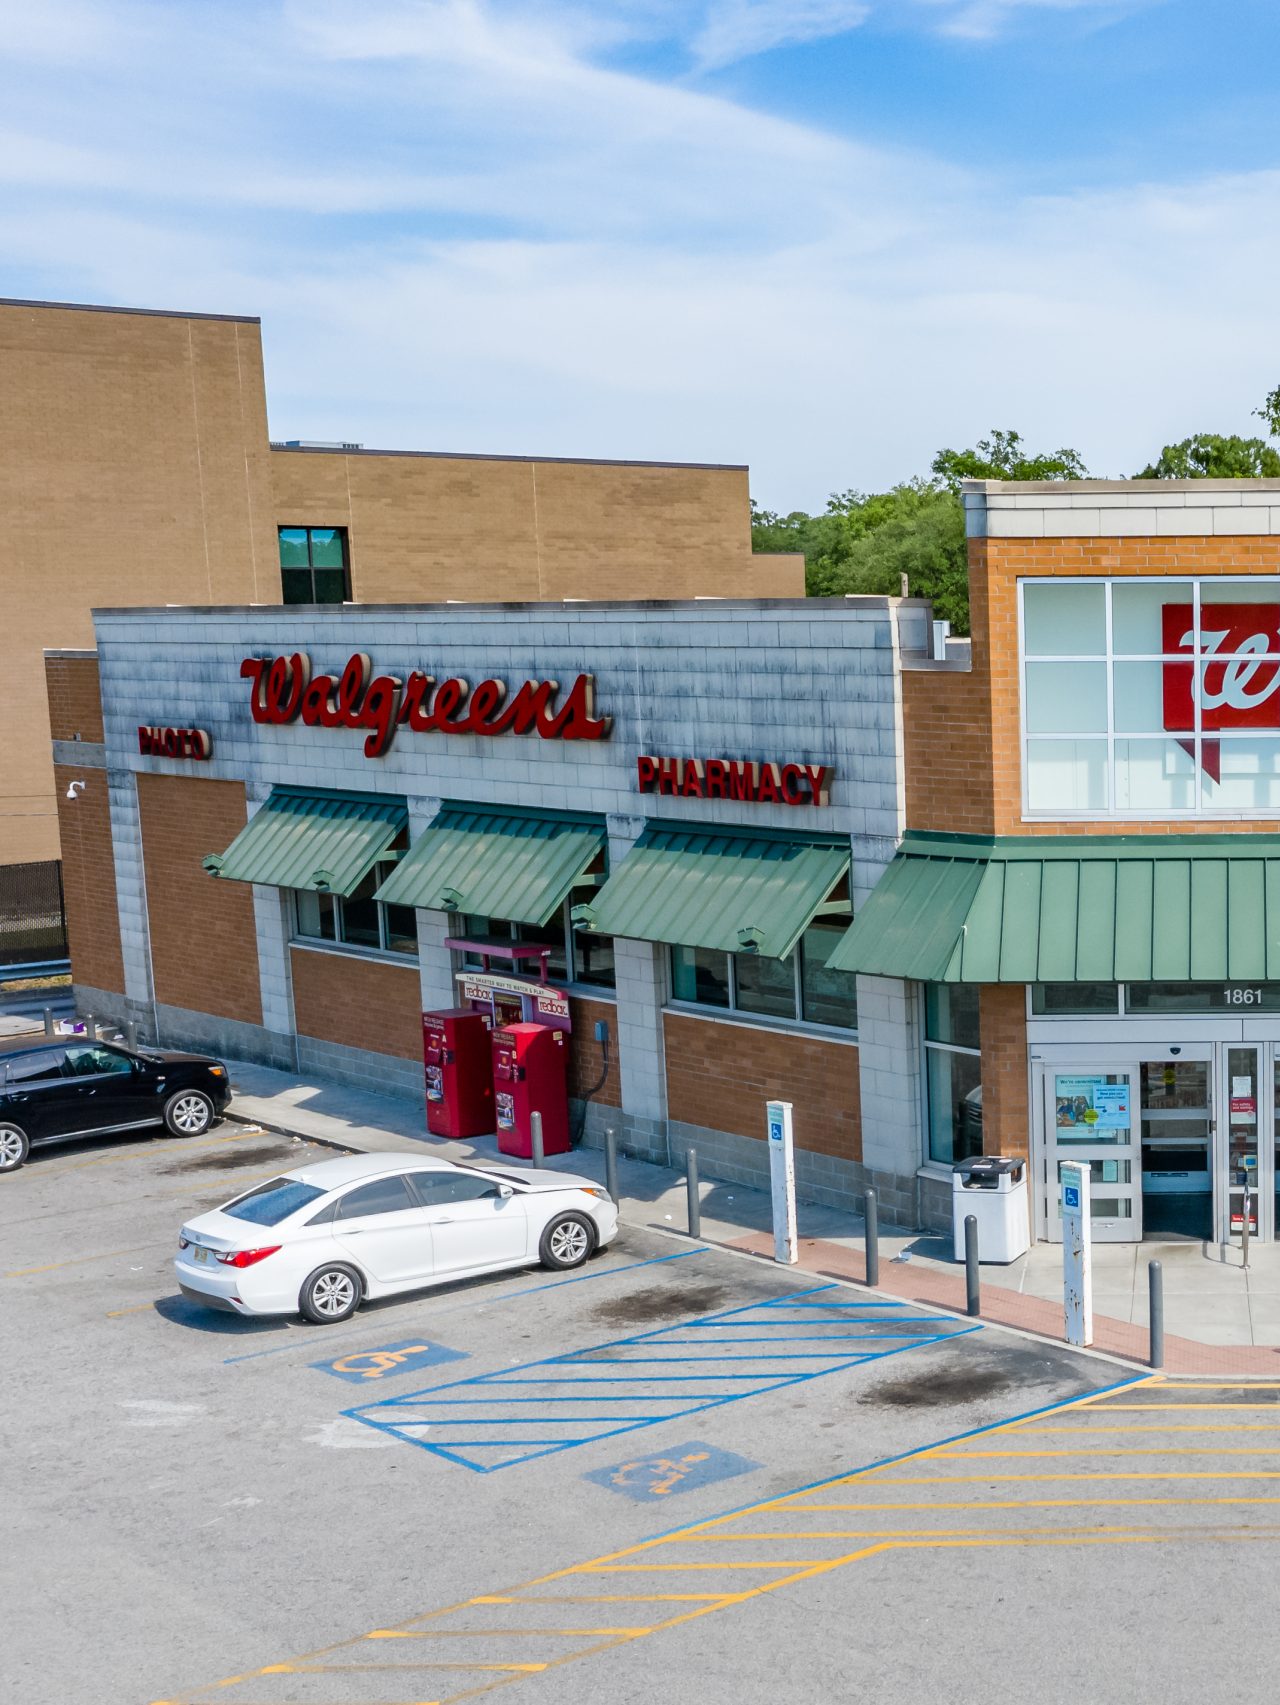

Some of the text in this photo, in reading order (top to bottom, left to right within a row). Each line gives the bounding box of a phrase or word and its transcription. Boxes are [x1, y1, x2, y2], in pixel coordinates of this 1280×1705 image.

[240, 652, 613, 758] Walgreens
[137, 726, 209, 761] PHOTO
[637, 756, 834, 806] PHARMACY
[1224, 989, 1262, 1004] 1861
